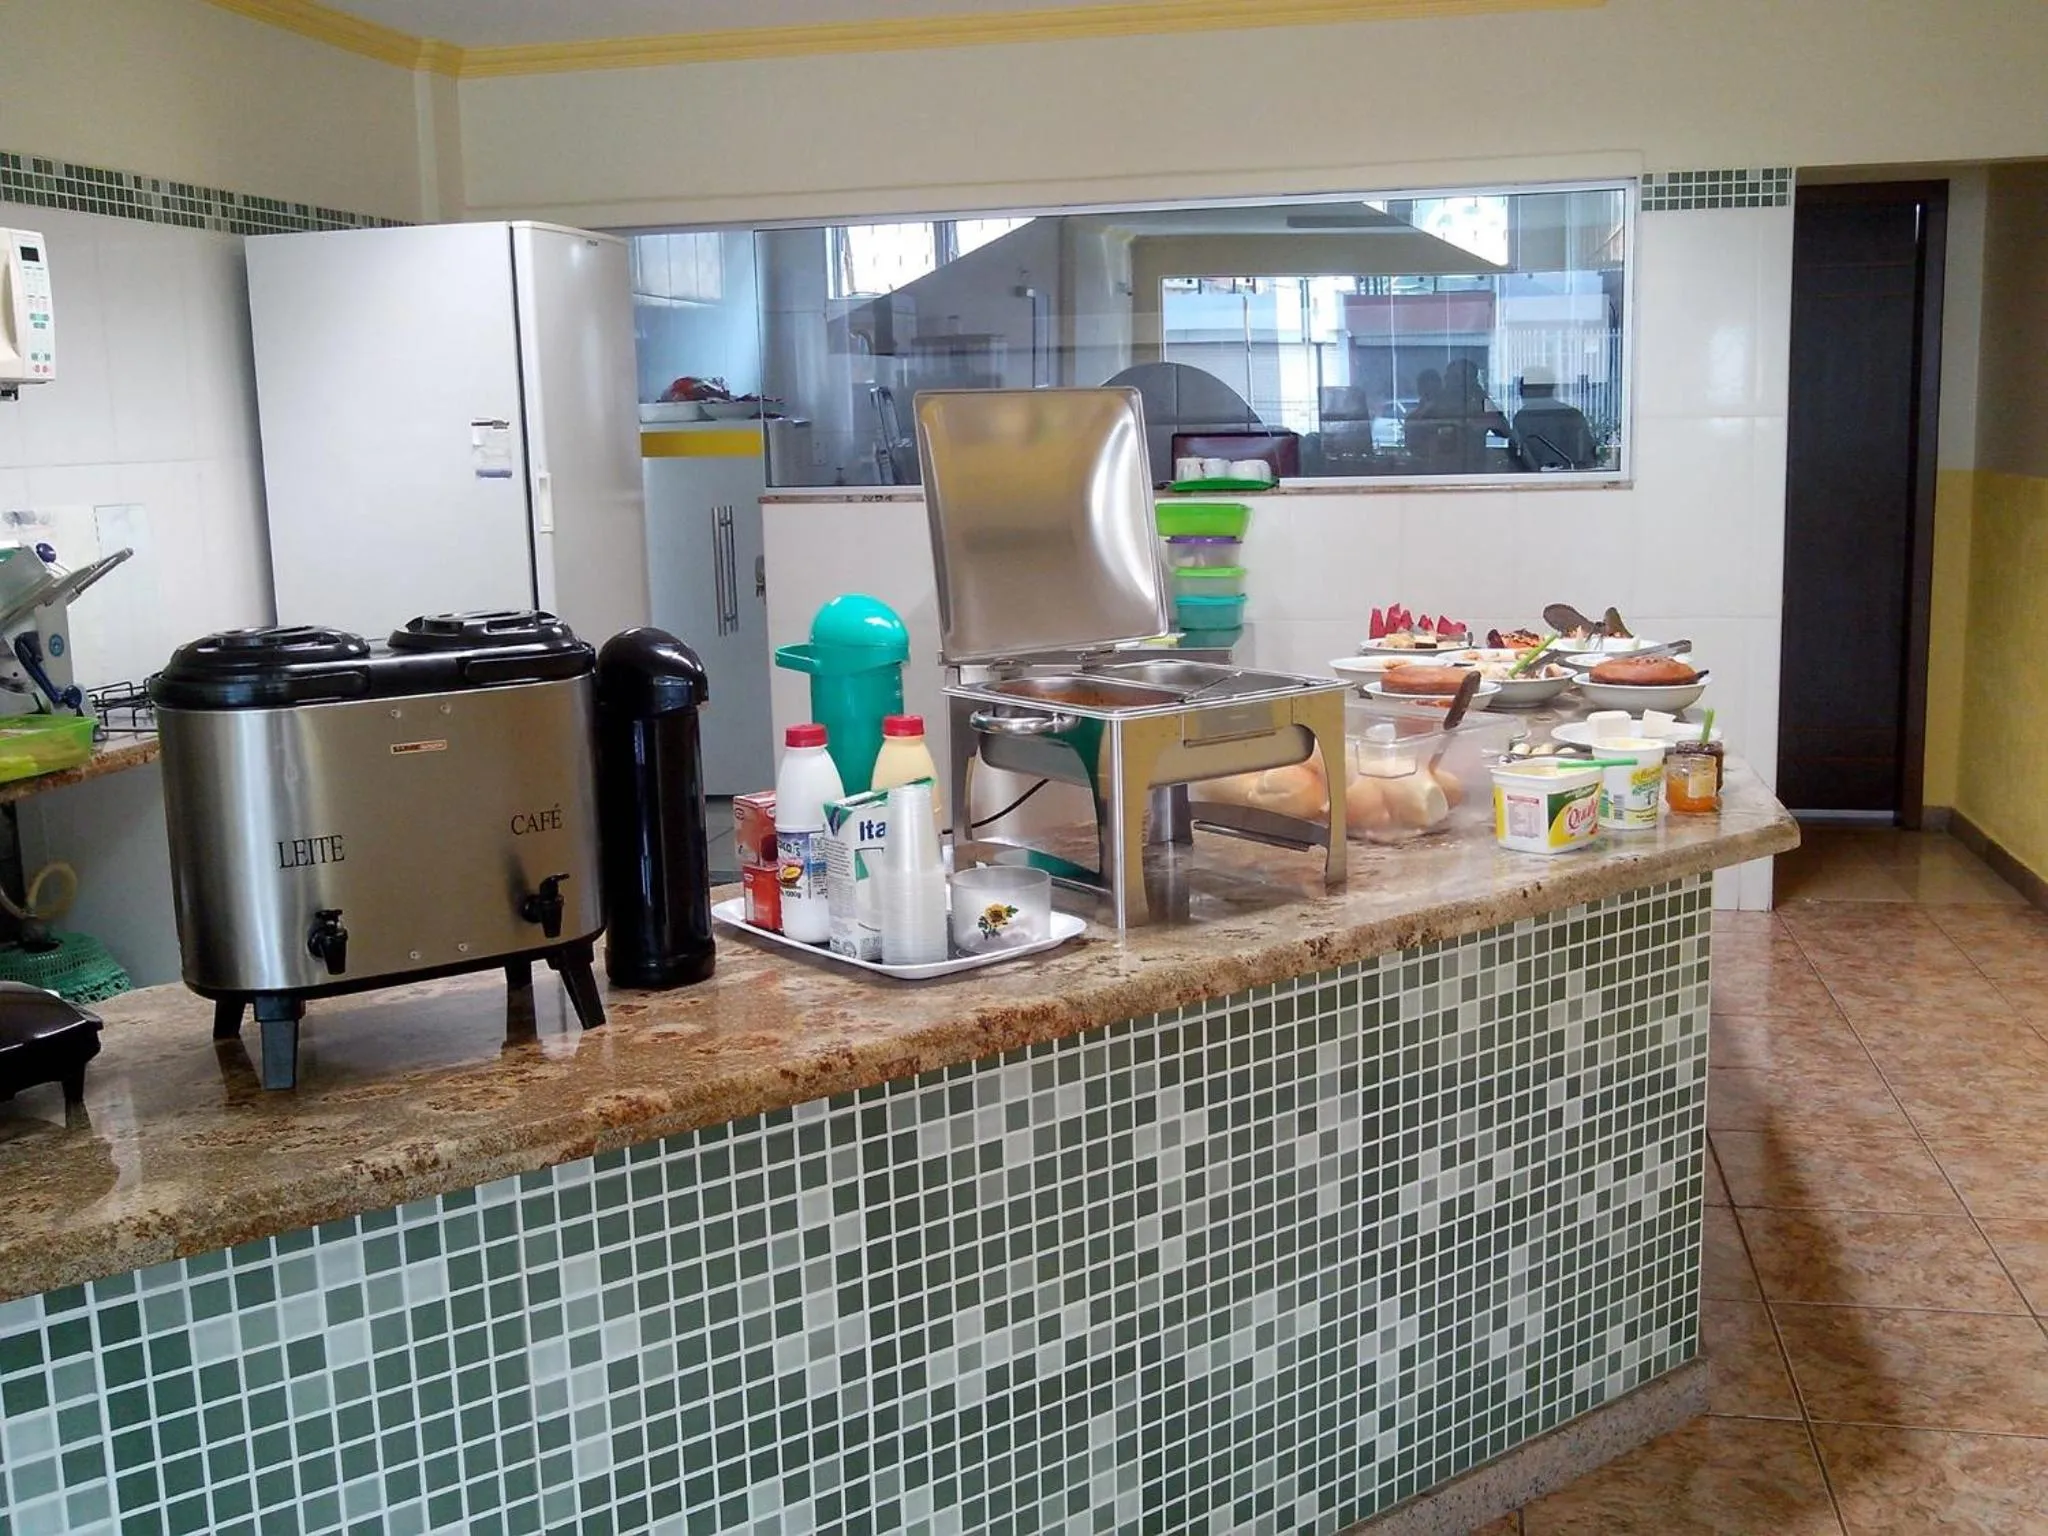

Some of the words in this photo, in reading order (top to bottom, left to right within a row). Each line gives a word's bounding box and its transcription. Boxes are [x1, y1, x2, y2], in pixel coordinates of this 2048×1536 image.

[511, 803, 562, 835] CAFÉ
[859, 820, 886, 841] Ita
[278, 835, 345, 868] LEITE
